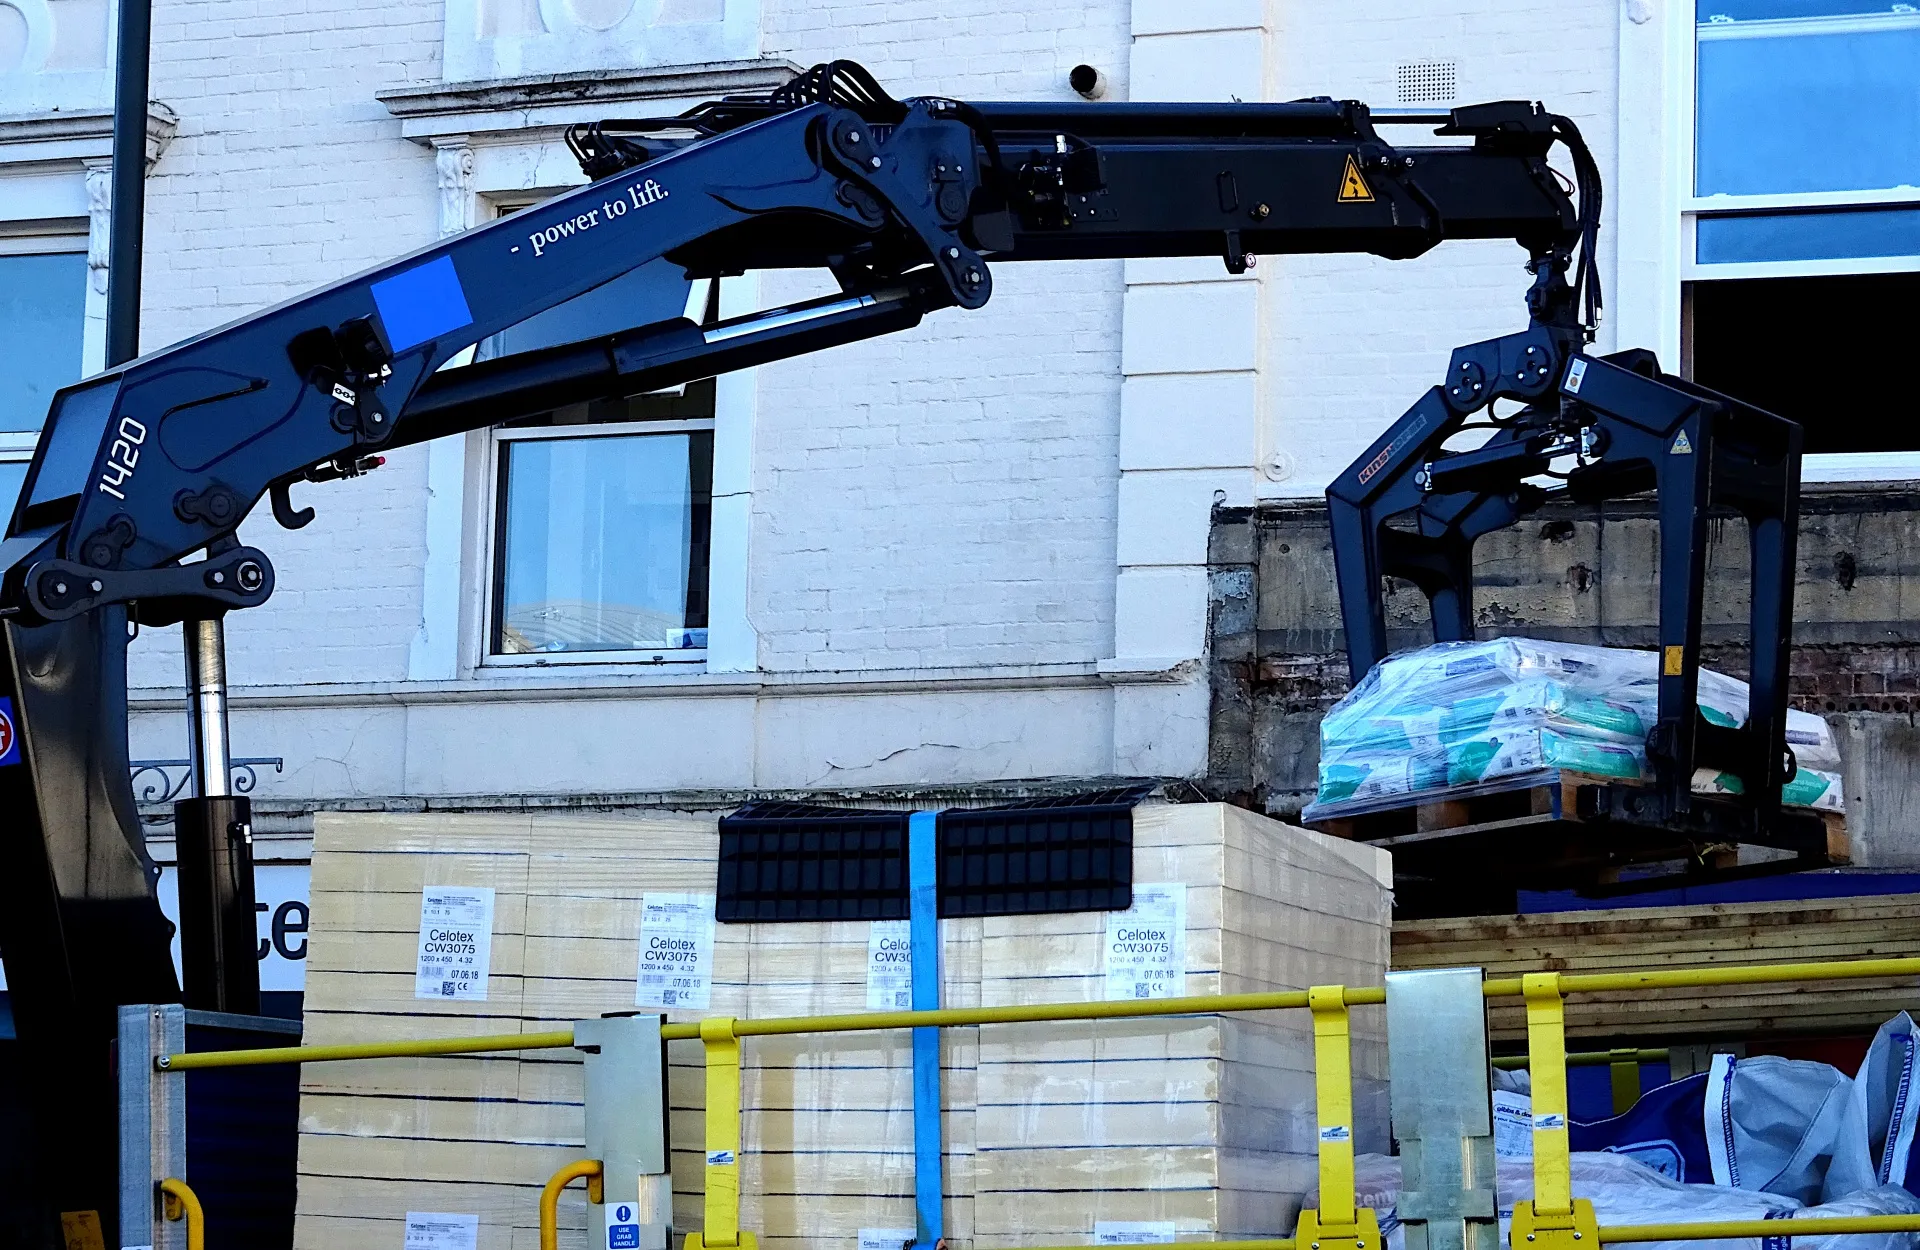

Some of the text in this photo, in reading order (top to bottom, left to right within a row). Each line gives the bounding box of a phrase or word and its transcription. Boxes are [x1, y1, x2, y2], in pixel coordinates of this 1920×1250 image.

[528, 209, 599, 257] power
[602, 199, 627, 220] to
[627, 179, 669, 210] lift.
[99, 416, 147, 500] 1420
[430, 929, 474, 942] Celotex
[1117, 928, 1166, 941] Celotex
[424, 942, 476, 954] CW3075
[650, 936, 696, 951] Celotex
[880, 938, 912, 951] Celo
[1112, 942, 1169, 953] CW3075
[645, 950, 698, 962] CW3075
[875, 951, 912, 963] CW30
[451, 969, 479, 980] 07.06.18
[1144, 970, 1175, 980] 07.06.18
[672, 978, 701, 988] 07.06.18
